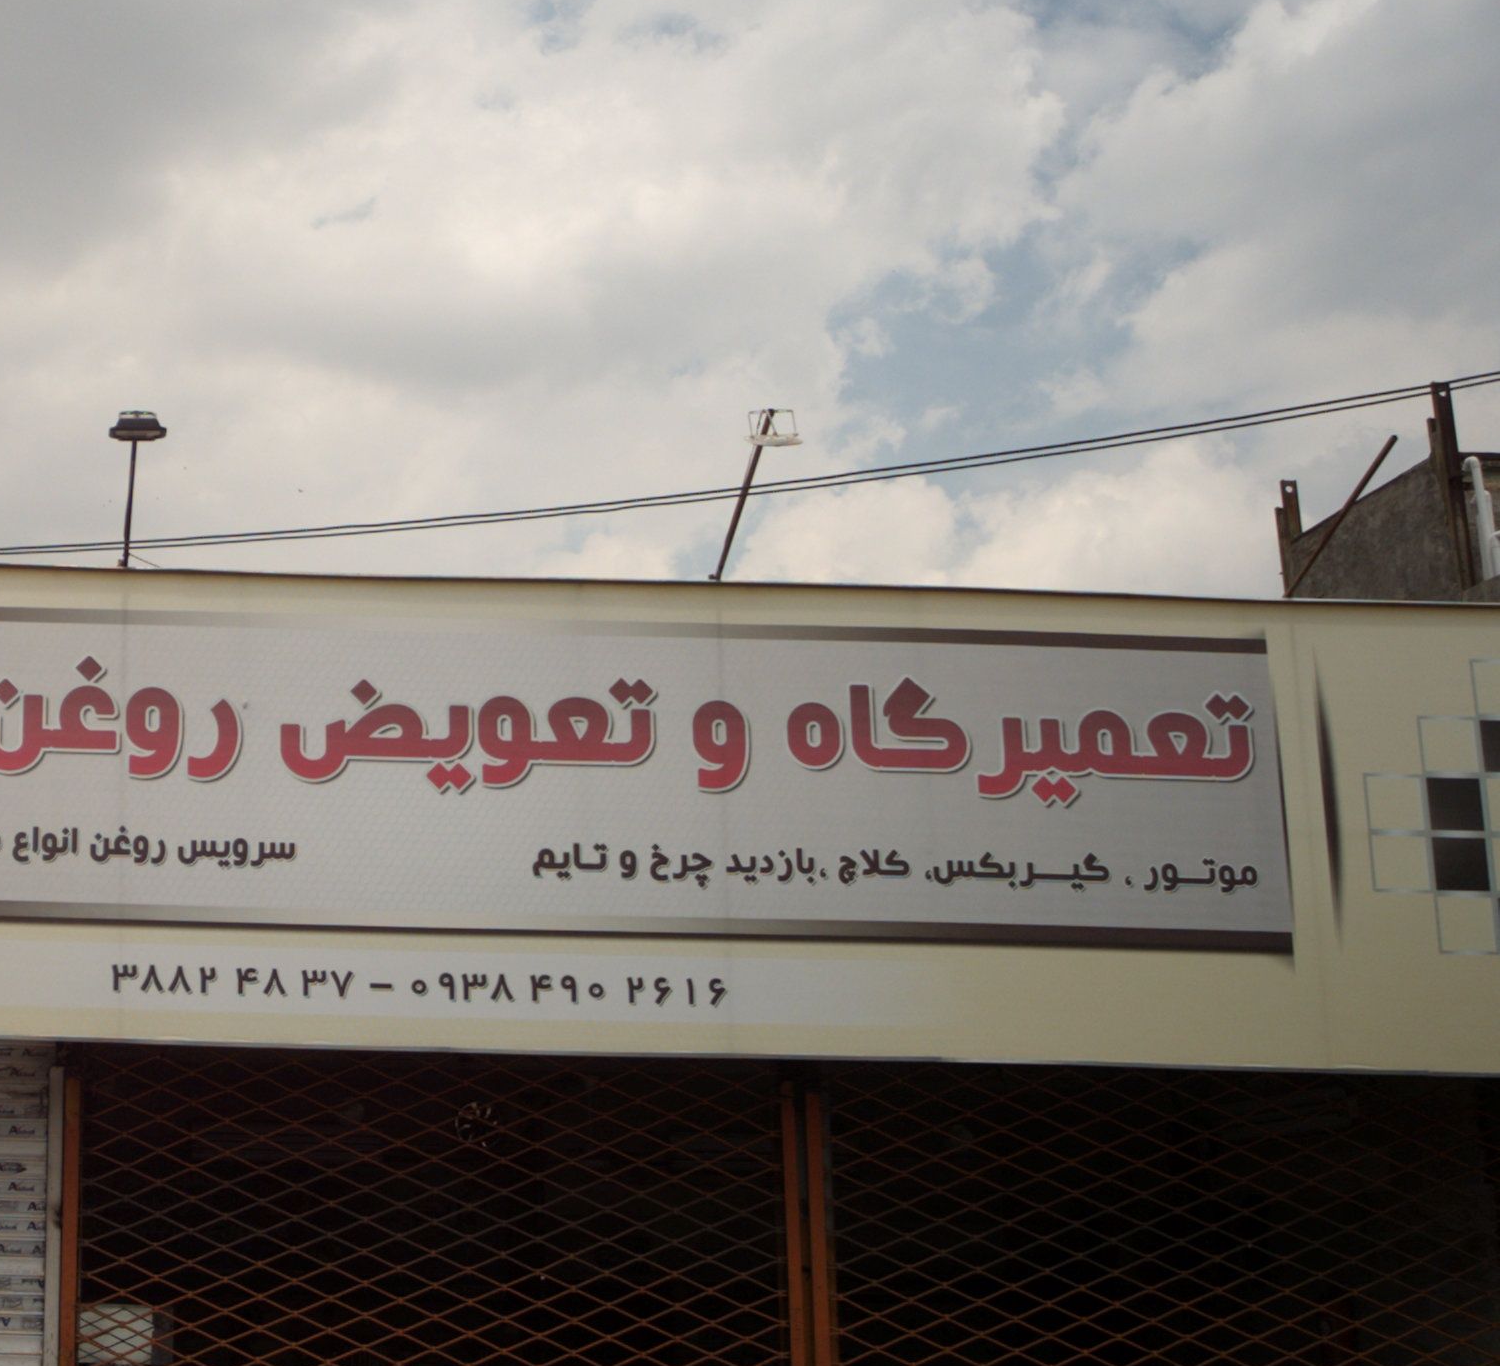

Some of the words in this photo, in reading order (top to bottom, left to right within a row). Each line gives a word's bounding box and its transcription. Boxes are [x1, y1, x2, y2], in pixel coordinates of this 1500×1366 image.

[278, 677, 658, 795] تعویض
[690, 697, 752, 793] و
[785, 675, 1258, 809] تعمیرگاه
[11, 826, 81, 864] انواع
[89, 826, 167, 866] روغن
[176, 838, 298, 869] سرویس
[531, 841, 610, 880] تایم
[618, 849, 639, 879] و
[649, 842, 714, 889] چرخ
[837, 848, 912, 886] کلاچ
[1143, 857, 1260, 893] موتور
[112, 964, 217, 994] ۳۸۸۲
[236, 967, 288, 997] ۴۸
[301, 969, 355, 999] ۳۷
[411, 972, 516, 1003] ۰۹۳۸
[530, 974, 606, 1004] ۴۹۰
[627, 976, 729, 1008] ۲۶۱۶
